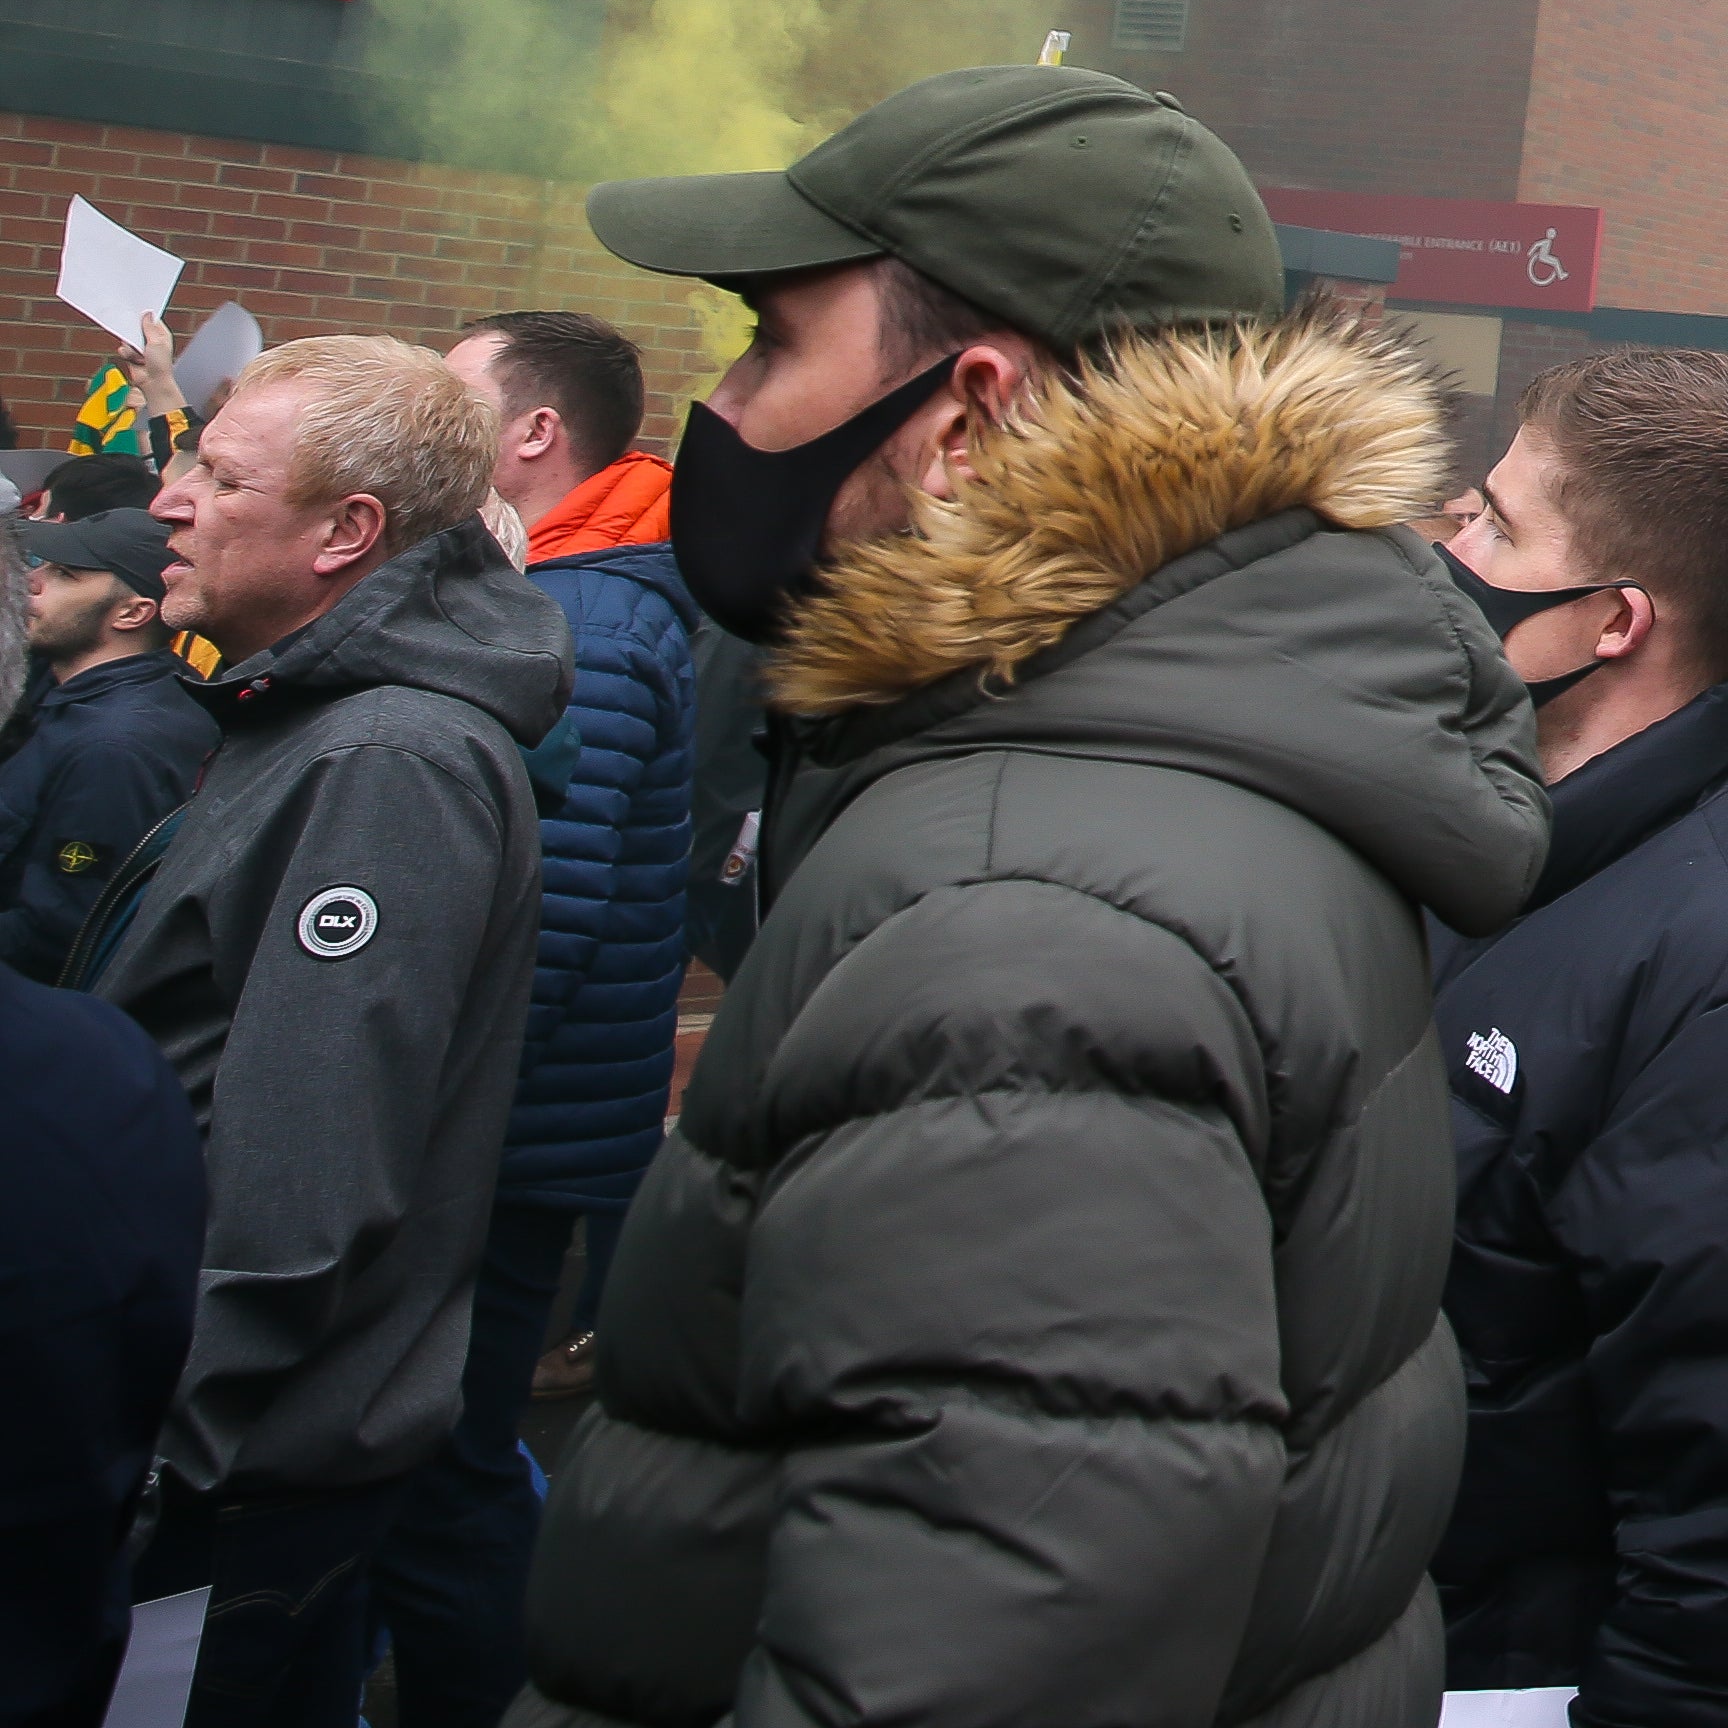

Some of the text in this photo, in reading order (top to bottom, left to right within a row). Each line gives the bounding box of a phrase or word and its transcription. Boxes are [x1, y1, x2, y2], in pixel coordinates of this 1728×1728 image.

[1466, 1031, 1501, 1068] NORTH
[1487, 1027, 1509, 1053] THE
[1465, 1050, 1497, 1080] FACE
